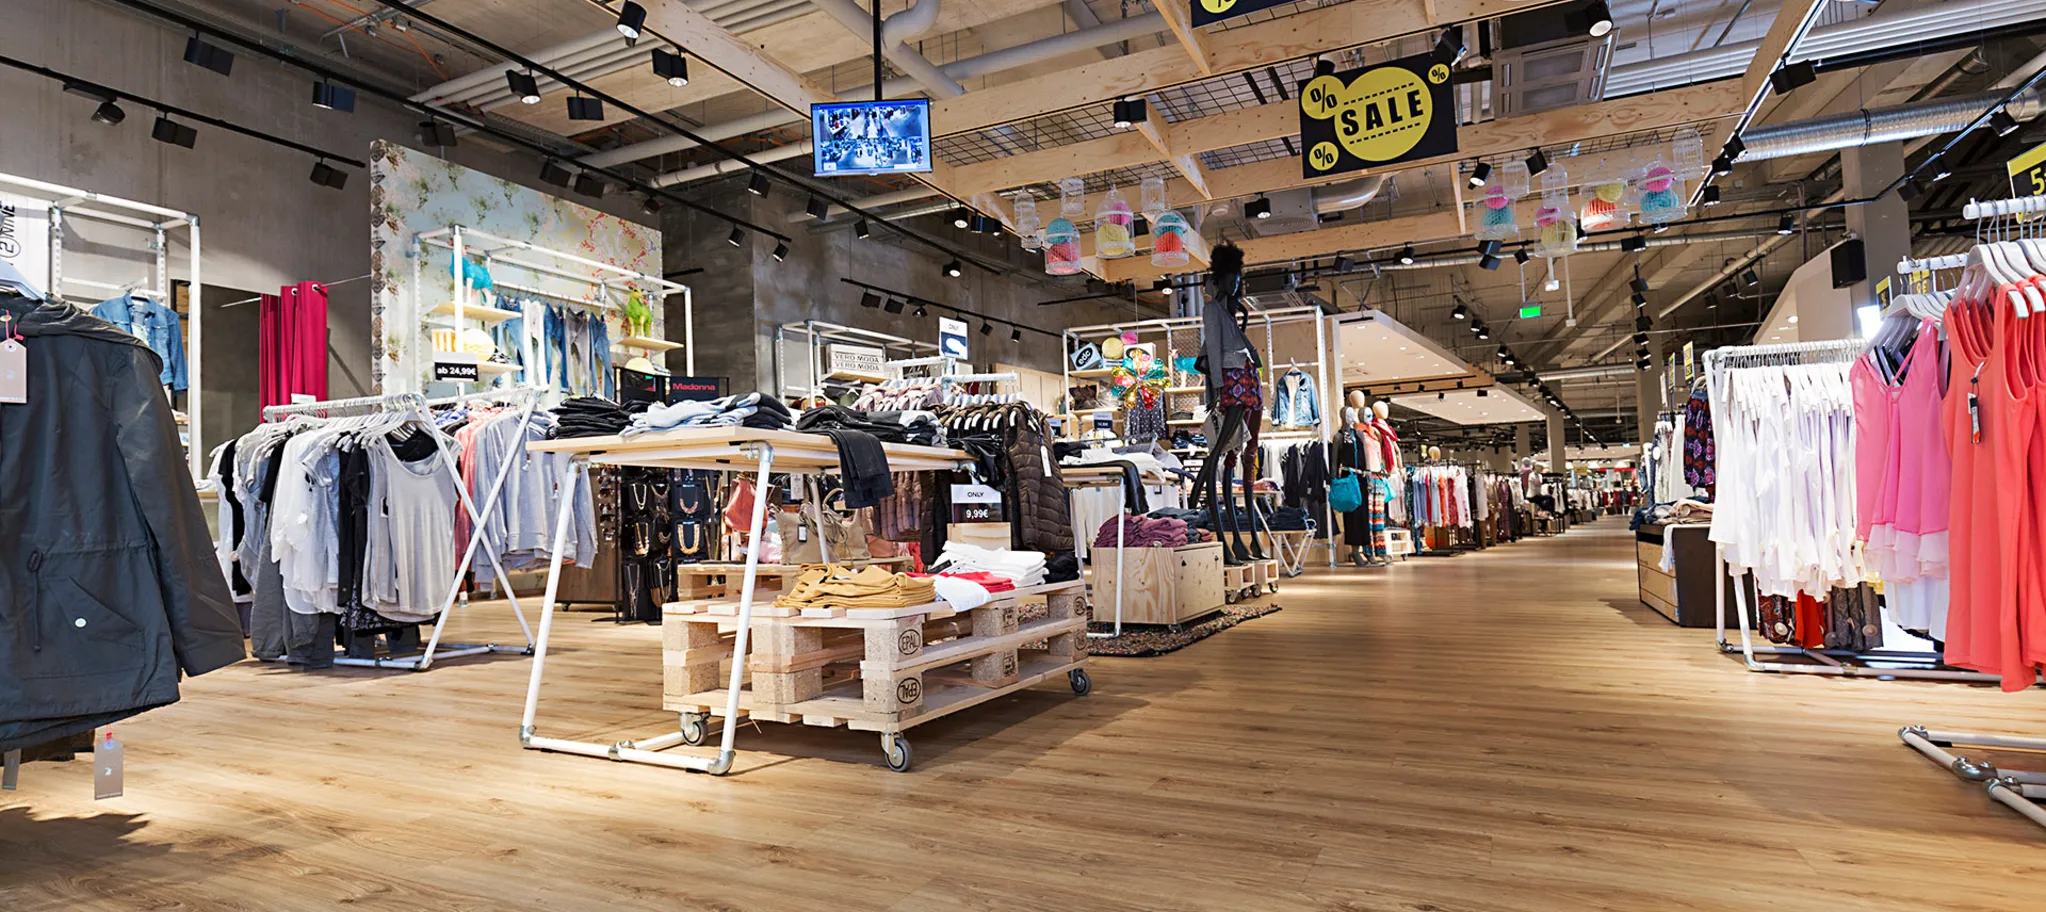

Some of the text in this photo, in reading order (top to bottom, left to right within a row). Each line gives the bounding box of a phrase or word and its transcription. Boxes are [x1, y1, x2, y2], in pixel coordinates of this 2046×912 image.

[1340, 89, 1424, 137] SALE
[834, 352, 879, 363] VERO MODA
[1078, 349, 1092, 365] edc
[437, 366, 477, 376] ab 24,99€
[834, 361, 880, 371] VERO MODA
[672, 383, 716, 391] Madonna
[965, 508, 989, 520] 9,99€
[902, 635, 919, 651] EPAL
[899, 682, 918, 699] EPAL
